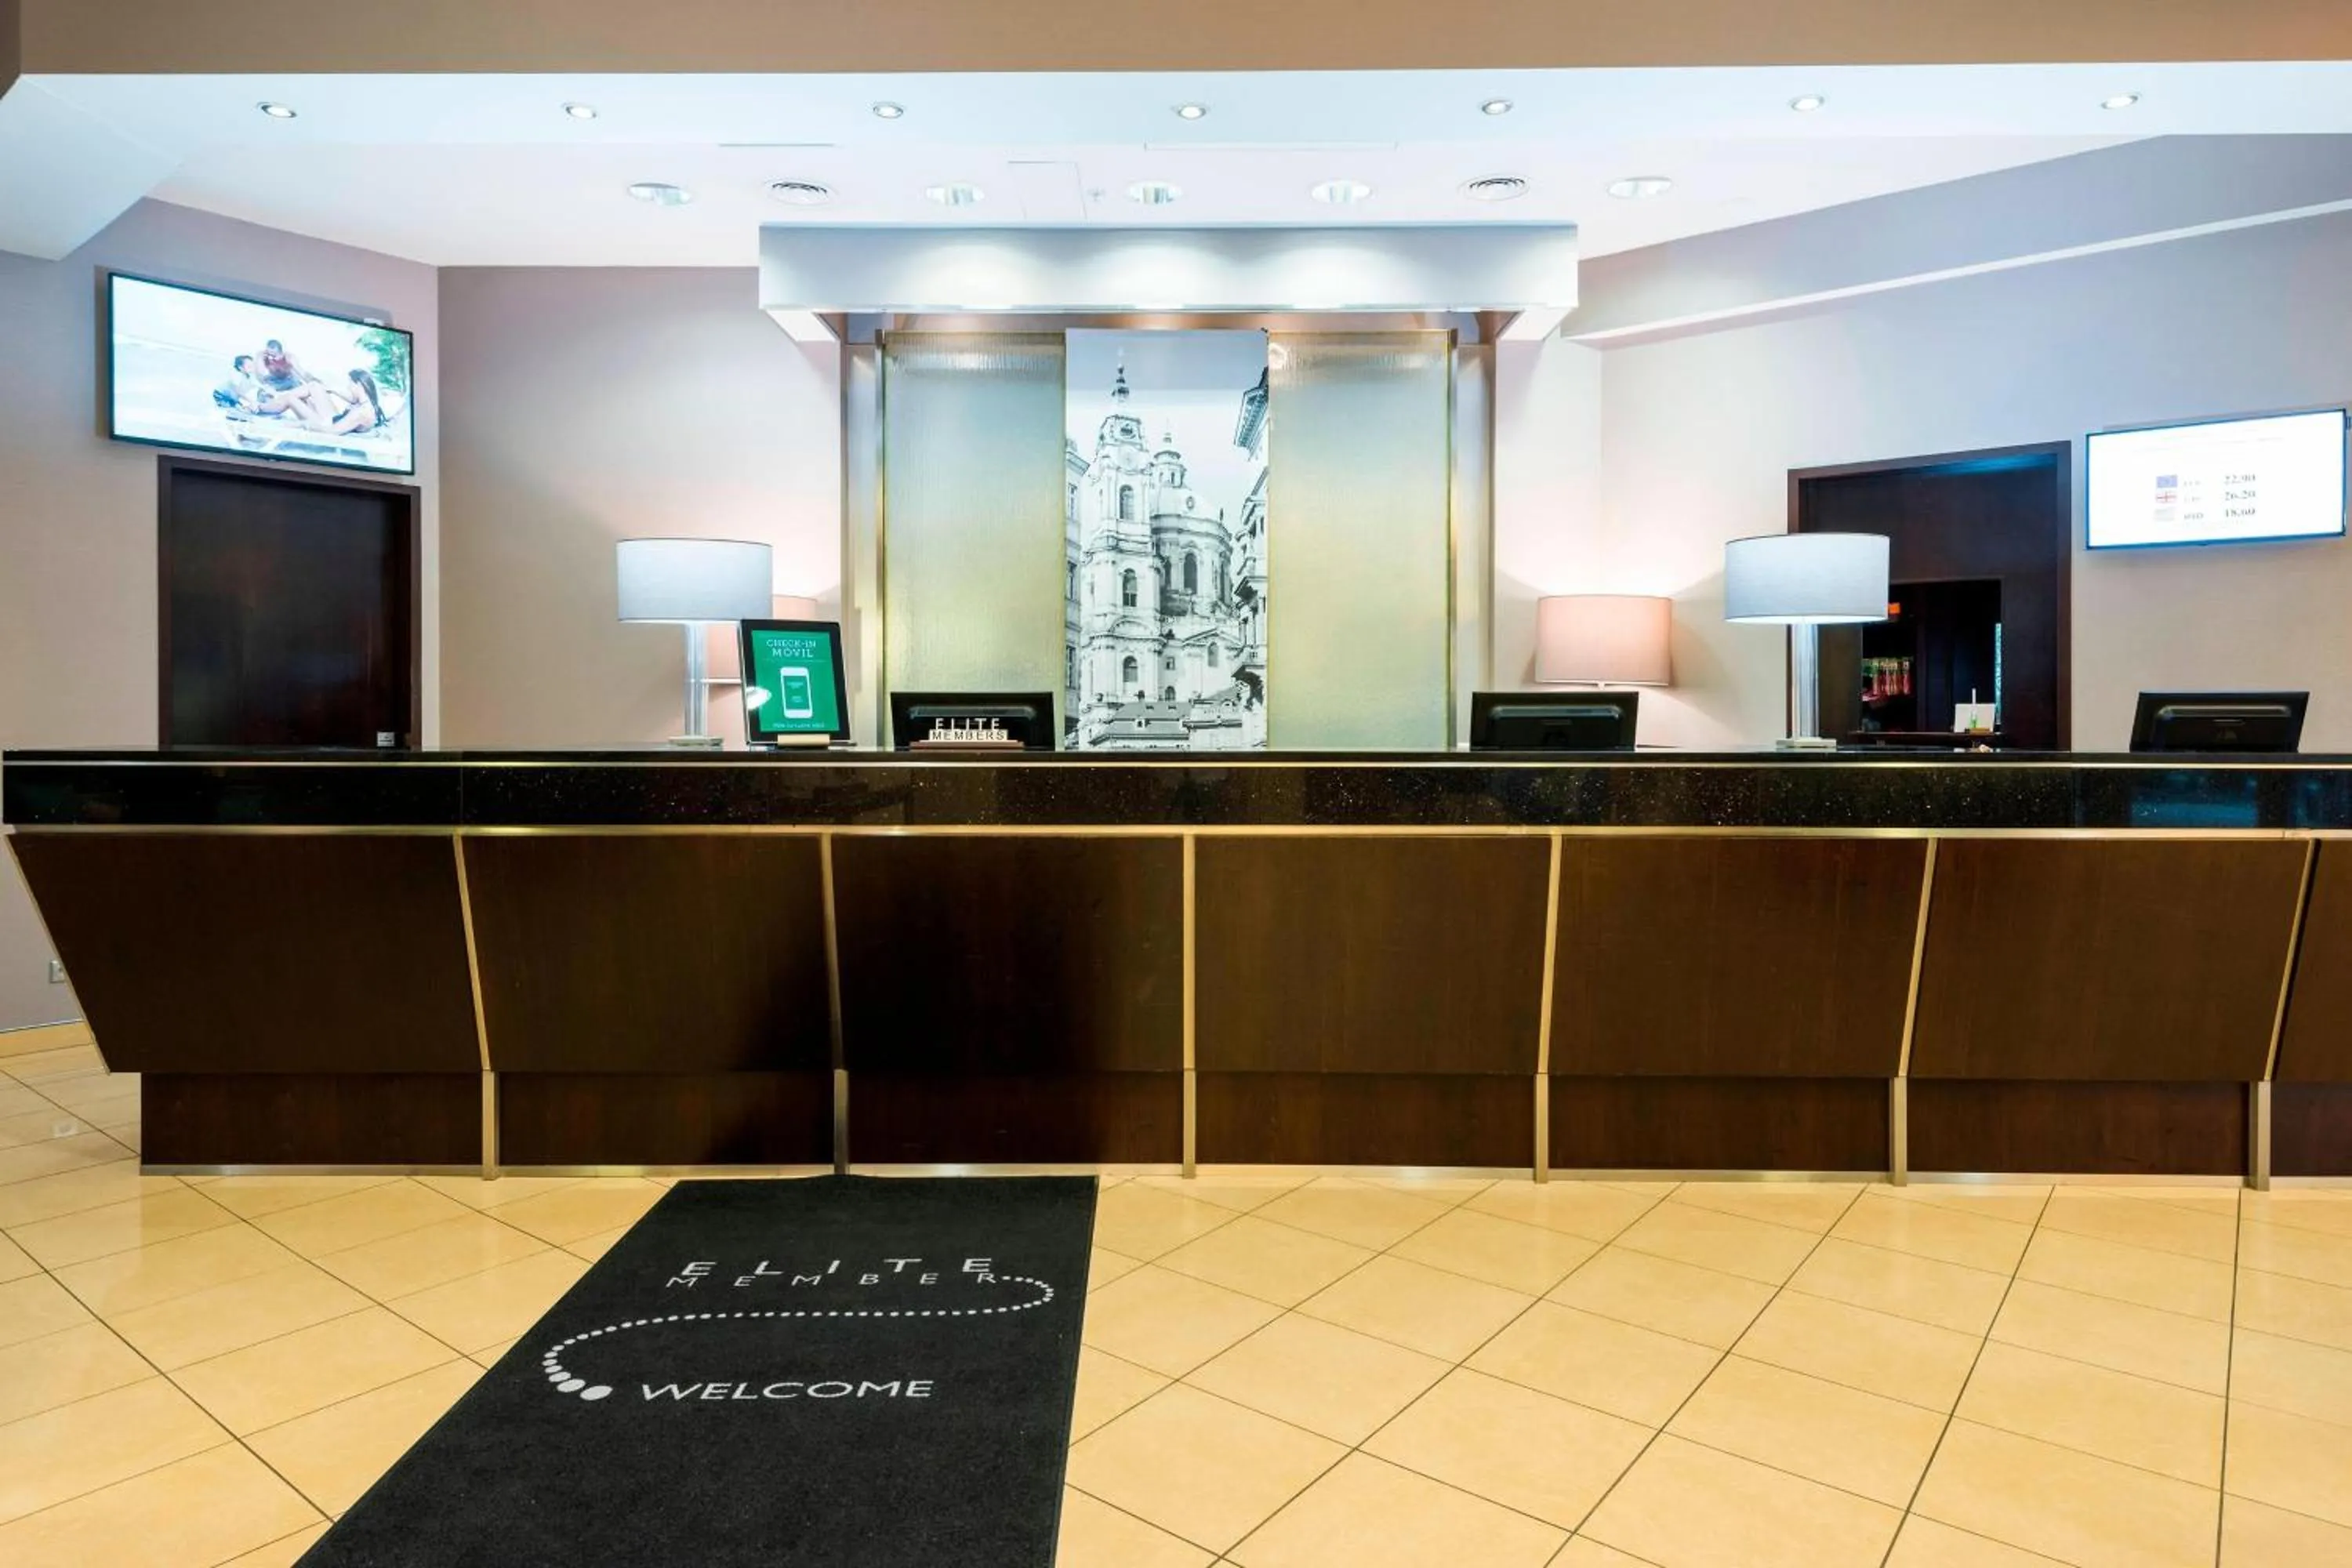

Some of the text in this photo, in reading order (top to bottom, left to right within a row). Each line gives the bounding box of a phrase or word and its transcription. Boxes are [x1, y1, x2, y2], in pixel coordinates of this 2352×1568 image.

[766, 639, 816, 648] CHECK-IN
[935, 717, 1000, 730] ELITE
[932, 730, 1006, 741] MEMBERS
[681, 1257, 993, 1276] ELITE
[665, 1272, 998, 1288] MEMBER
[641, 1379, 935, 1401] WELCOME
